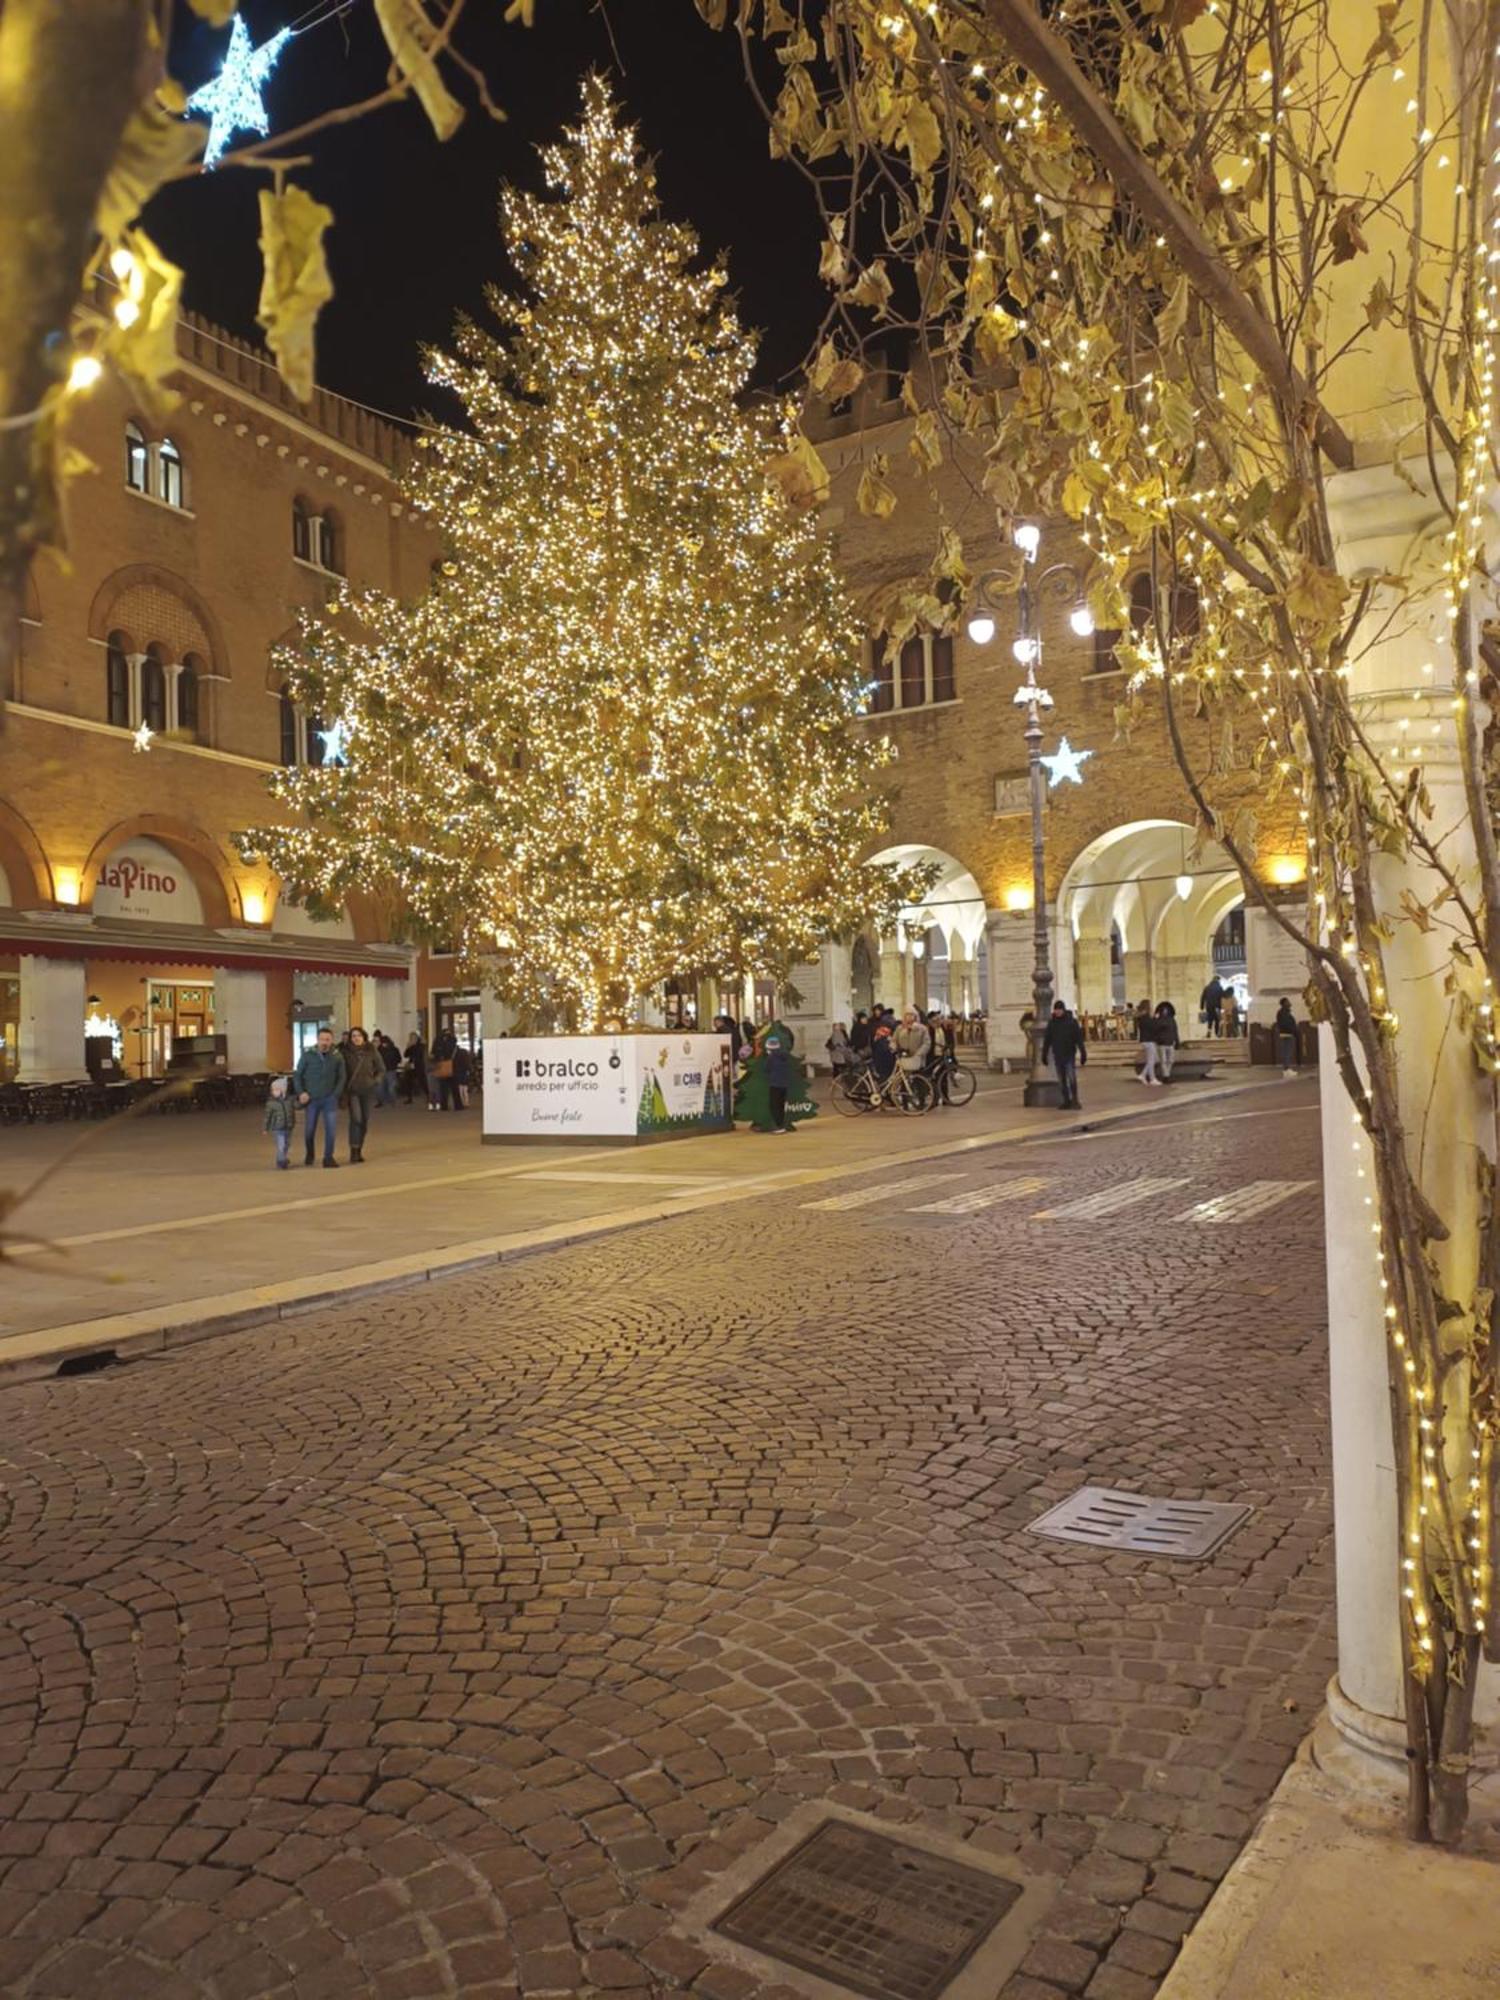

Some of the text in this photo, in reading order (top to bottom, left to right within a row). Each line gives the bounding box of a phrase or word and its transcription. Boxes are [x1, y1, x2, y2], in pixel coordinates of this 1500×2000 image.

[535, 1059, 599, 1077] bralco
[683, 1072, 702, 1085] CMB
[516, 1080, 599, 1092] arredo per ufficio
